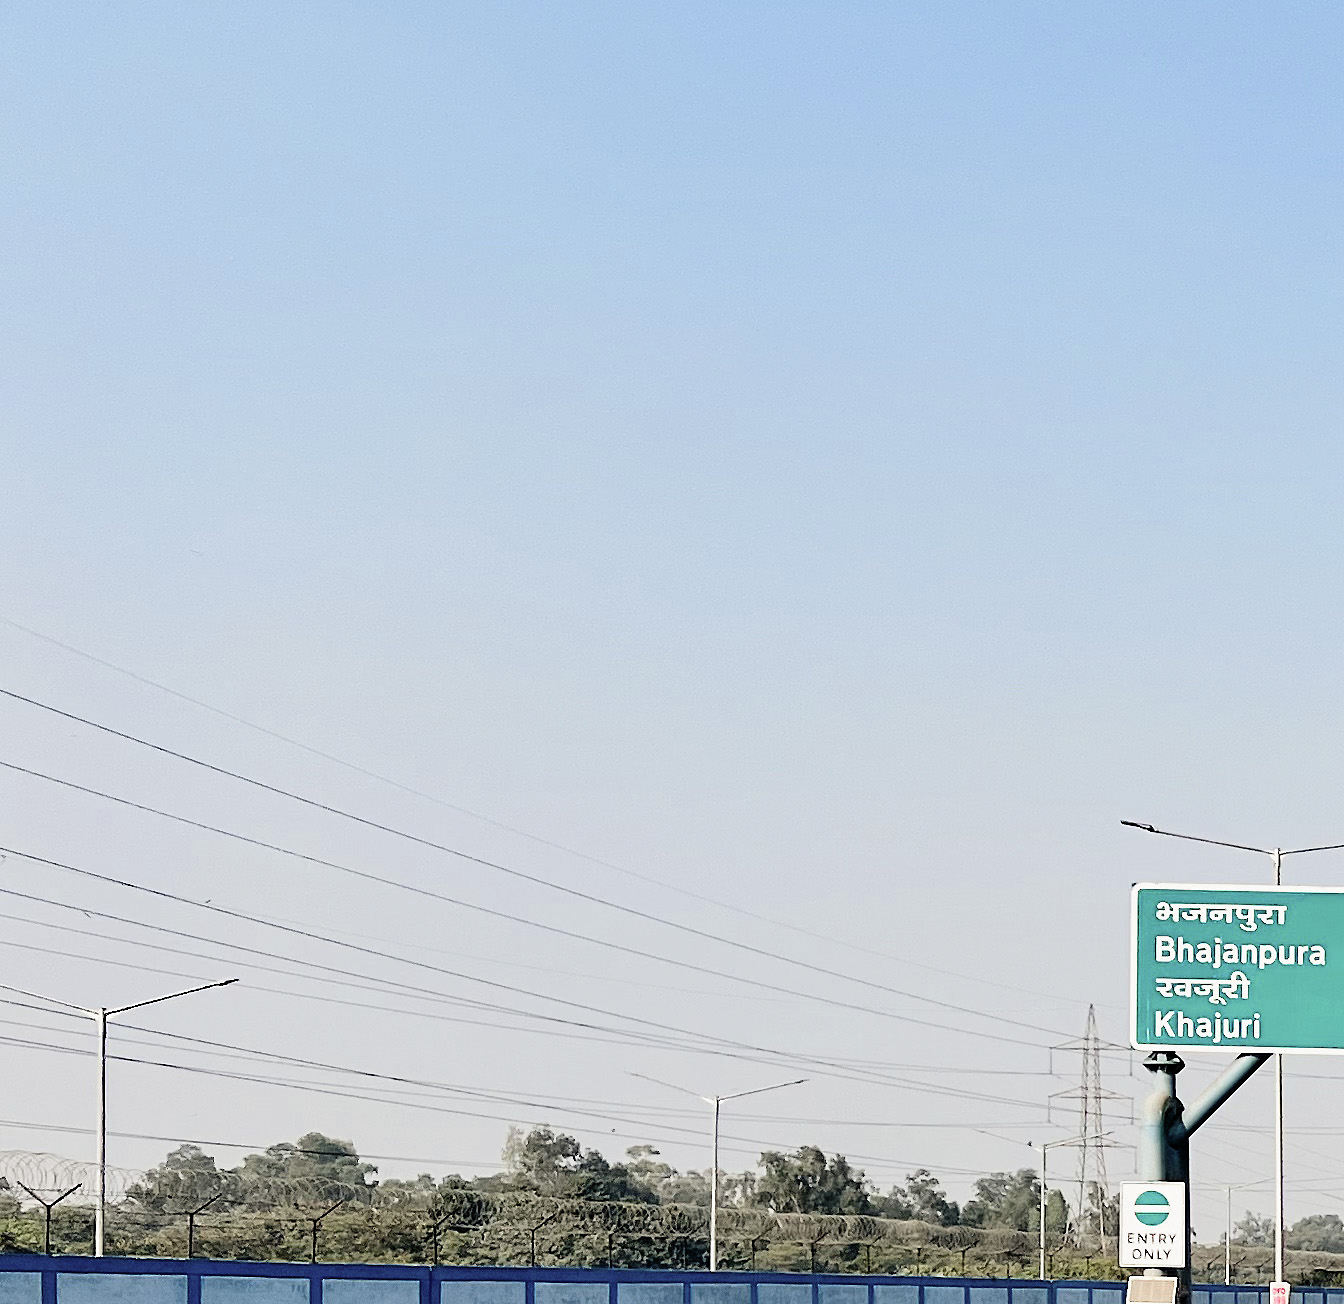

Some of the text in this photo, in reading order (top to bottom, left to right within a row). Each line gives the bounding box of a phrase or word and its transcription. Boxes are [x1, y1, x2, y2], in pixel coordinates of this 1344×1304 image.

[1155, 901, 1288, 932] भजनपुरा
[1155, 935, 1326, 969] Bhajanpura
[1155, 1010, 1261, 1043] Khajuri
[1127, 1232, 1176, 1244] ENTRY
[1132, 1248, 1172, 1260] ONLY
